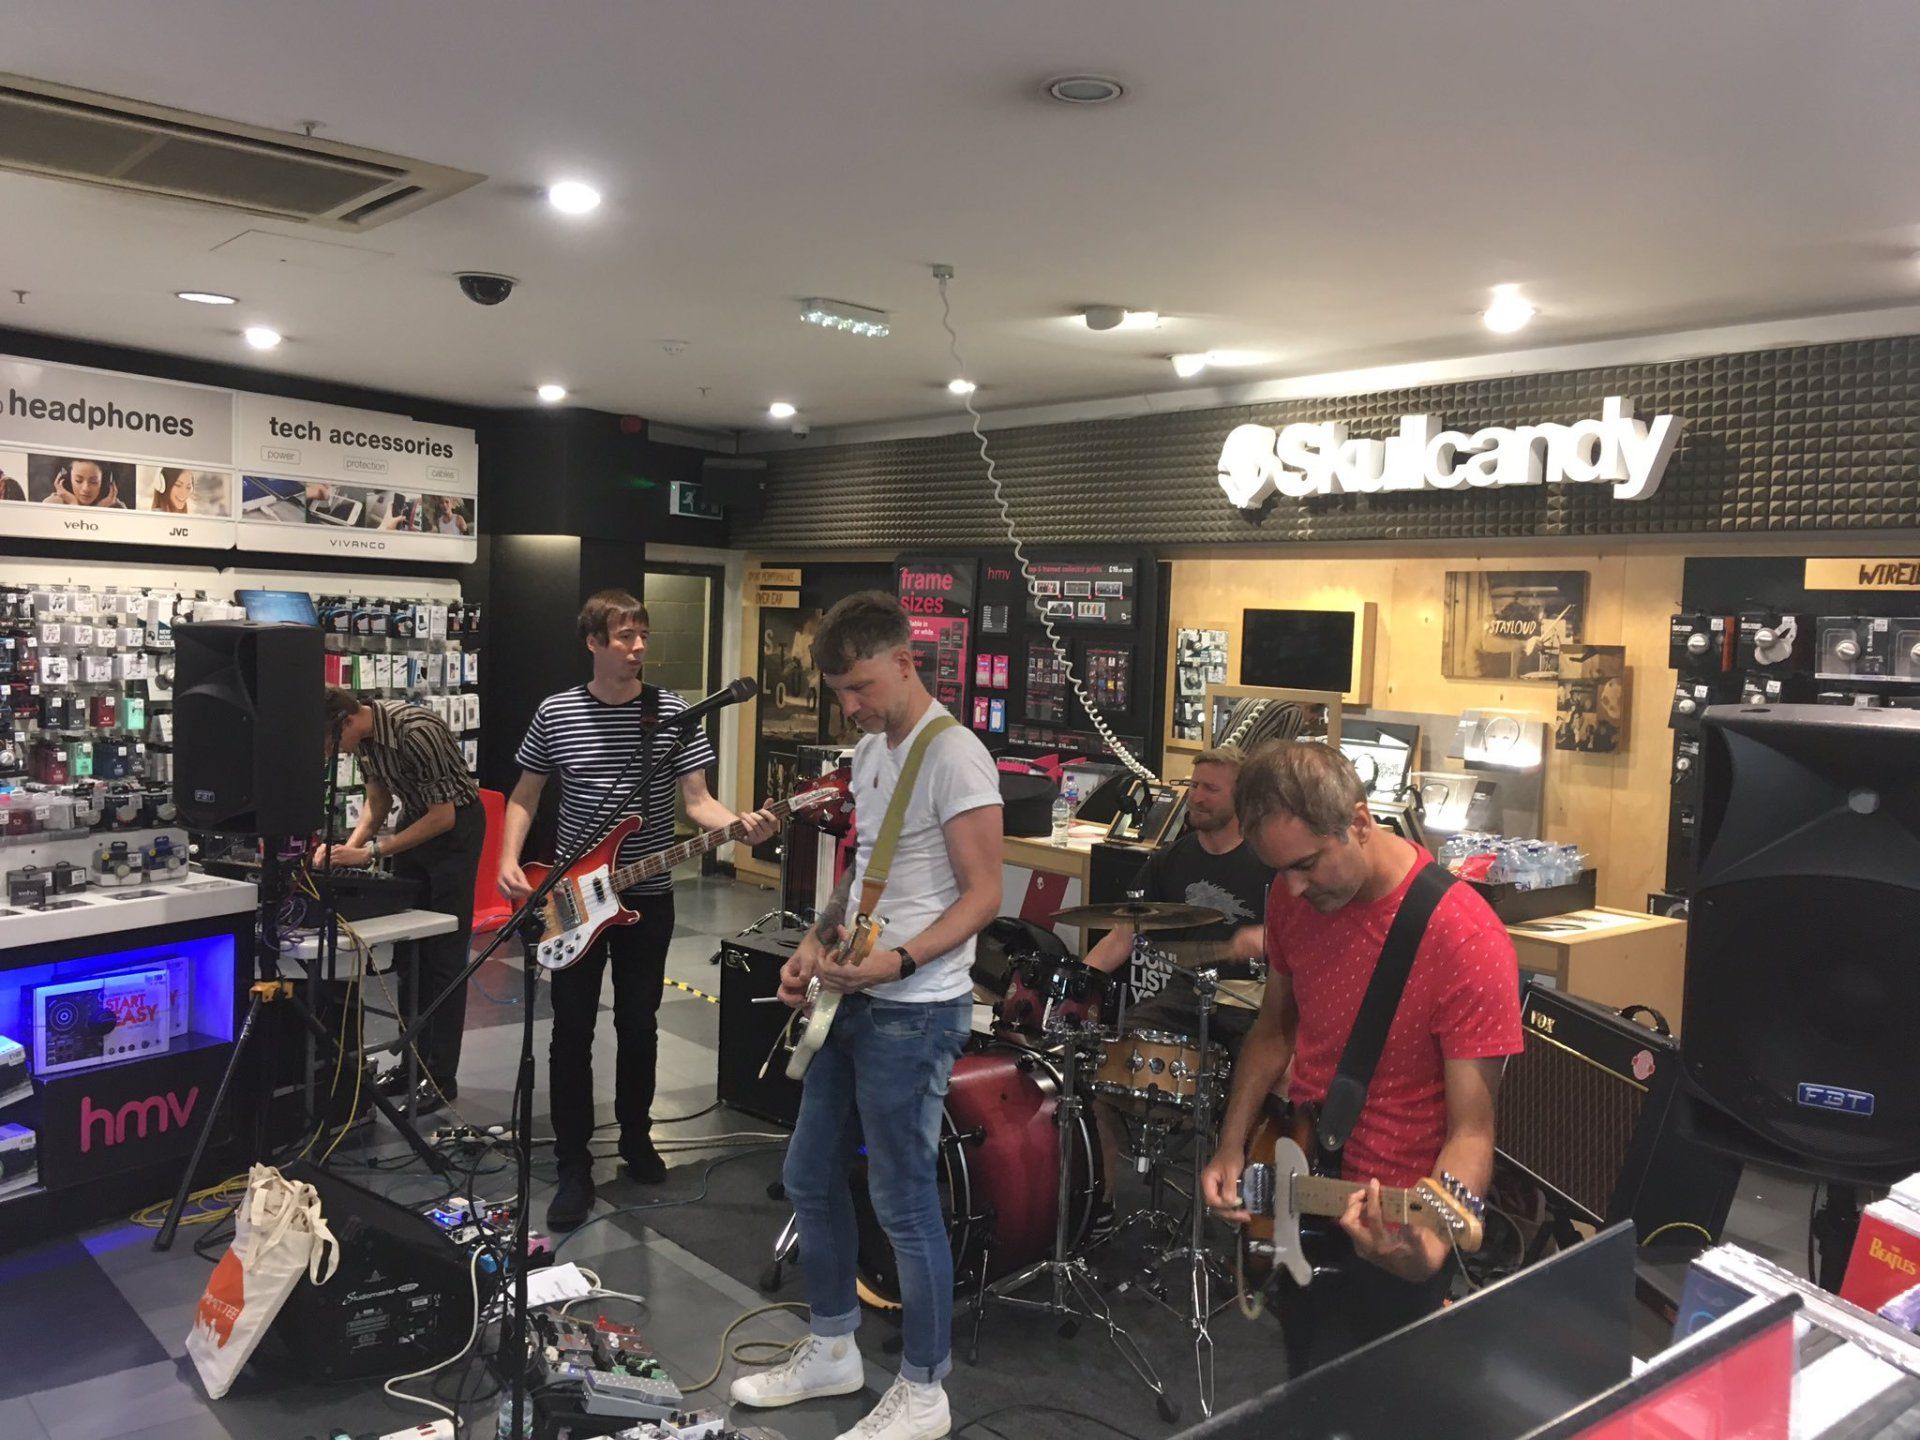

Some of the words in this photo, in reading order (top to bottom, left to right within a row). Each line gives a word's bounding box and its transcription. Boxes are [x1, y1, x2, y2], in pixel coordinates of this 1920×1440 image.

[9, 388, 195, 438] headphones
[269, 416, 321, 443] tech
[329, 428, 454, 459] accessories
[1274, 397, 1682, 499] Skullcandy
[267, 450, 295, 462] power
[346, 458, 386, 472] protection
[431, 469, 455, 480] cables
[63, 518, 99, 532] veho
[169, 528, 189, 538] JVC
[330, 539, 386, 551] VIVANCO
[901, 567, 953, 590] frame
[987, 567, 1011, 580] hmv
[901, 591, 944, 613] sizes
[1131, 949, 1178, 974] DON'
[106, 993, 146, 1010] START
[1530, 1009, 1556, 1034] VOX
[1804, 1087, 1866, 1109] FBT
[80, 1086, 199, 1153] hmv
[1868, 1237, 1917, 1276] BEATLES
